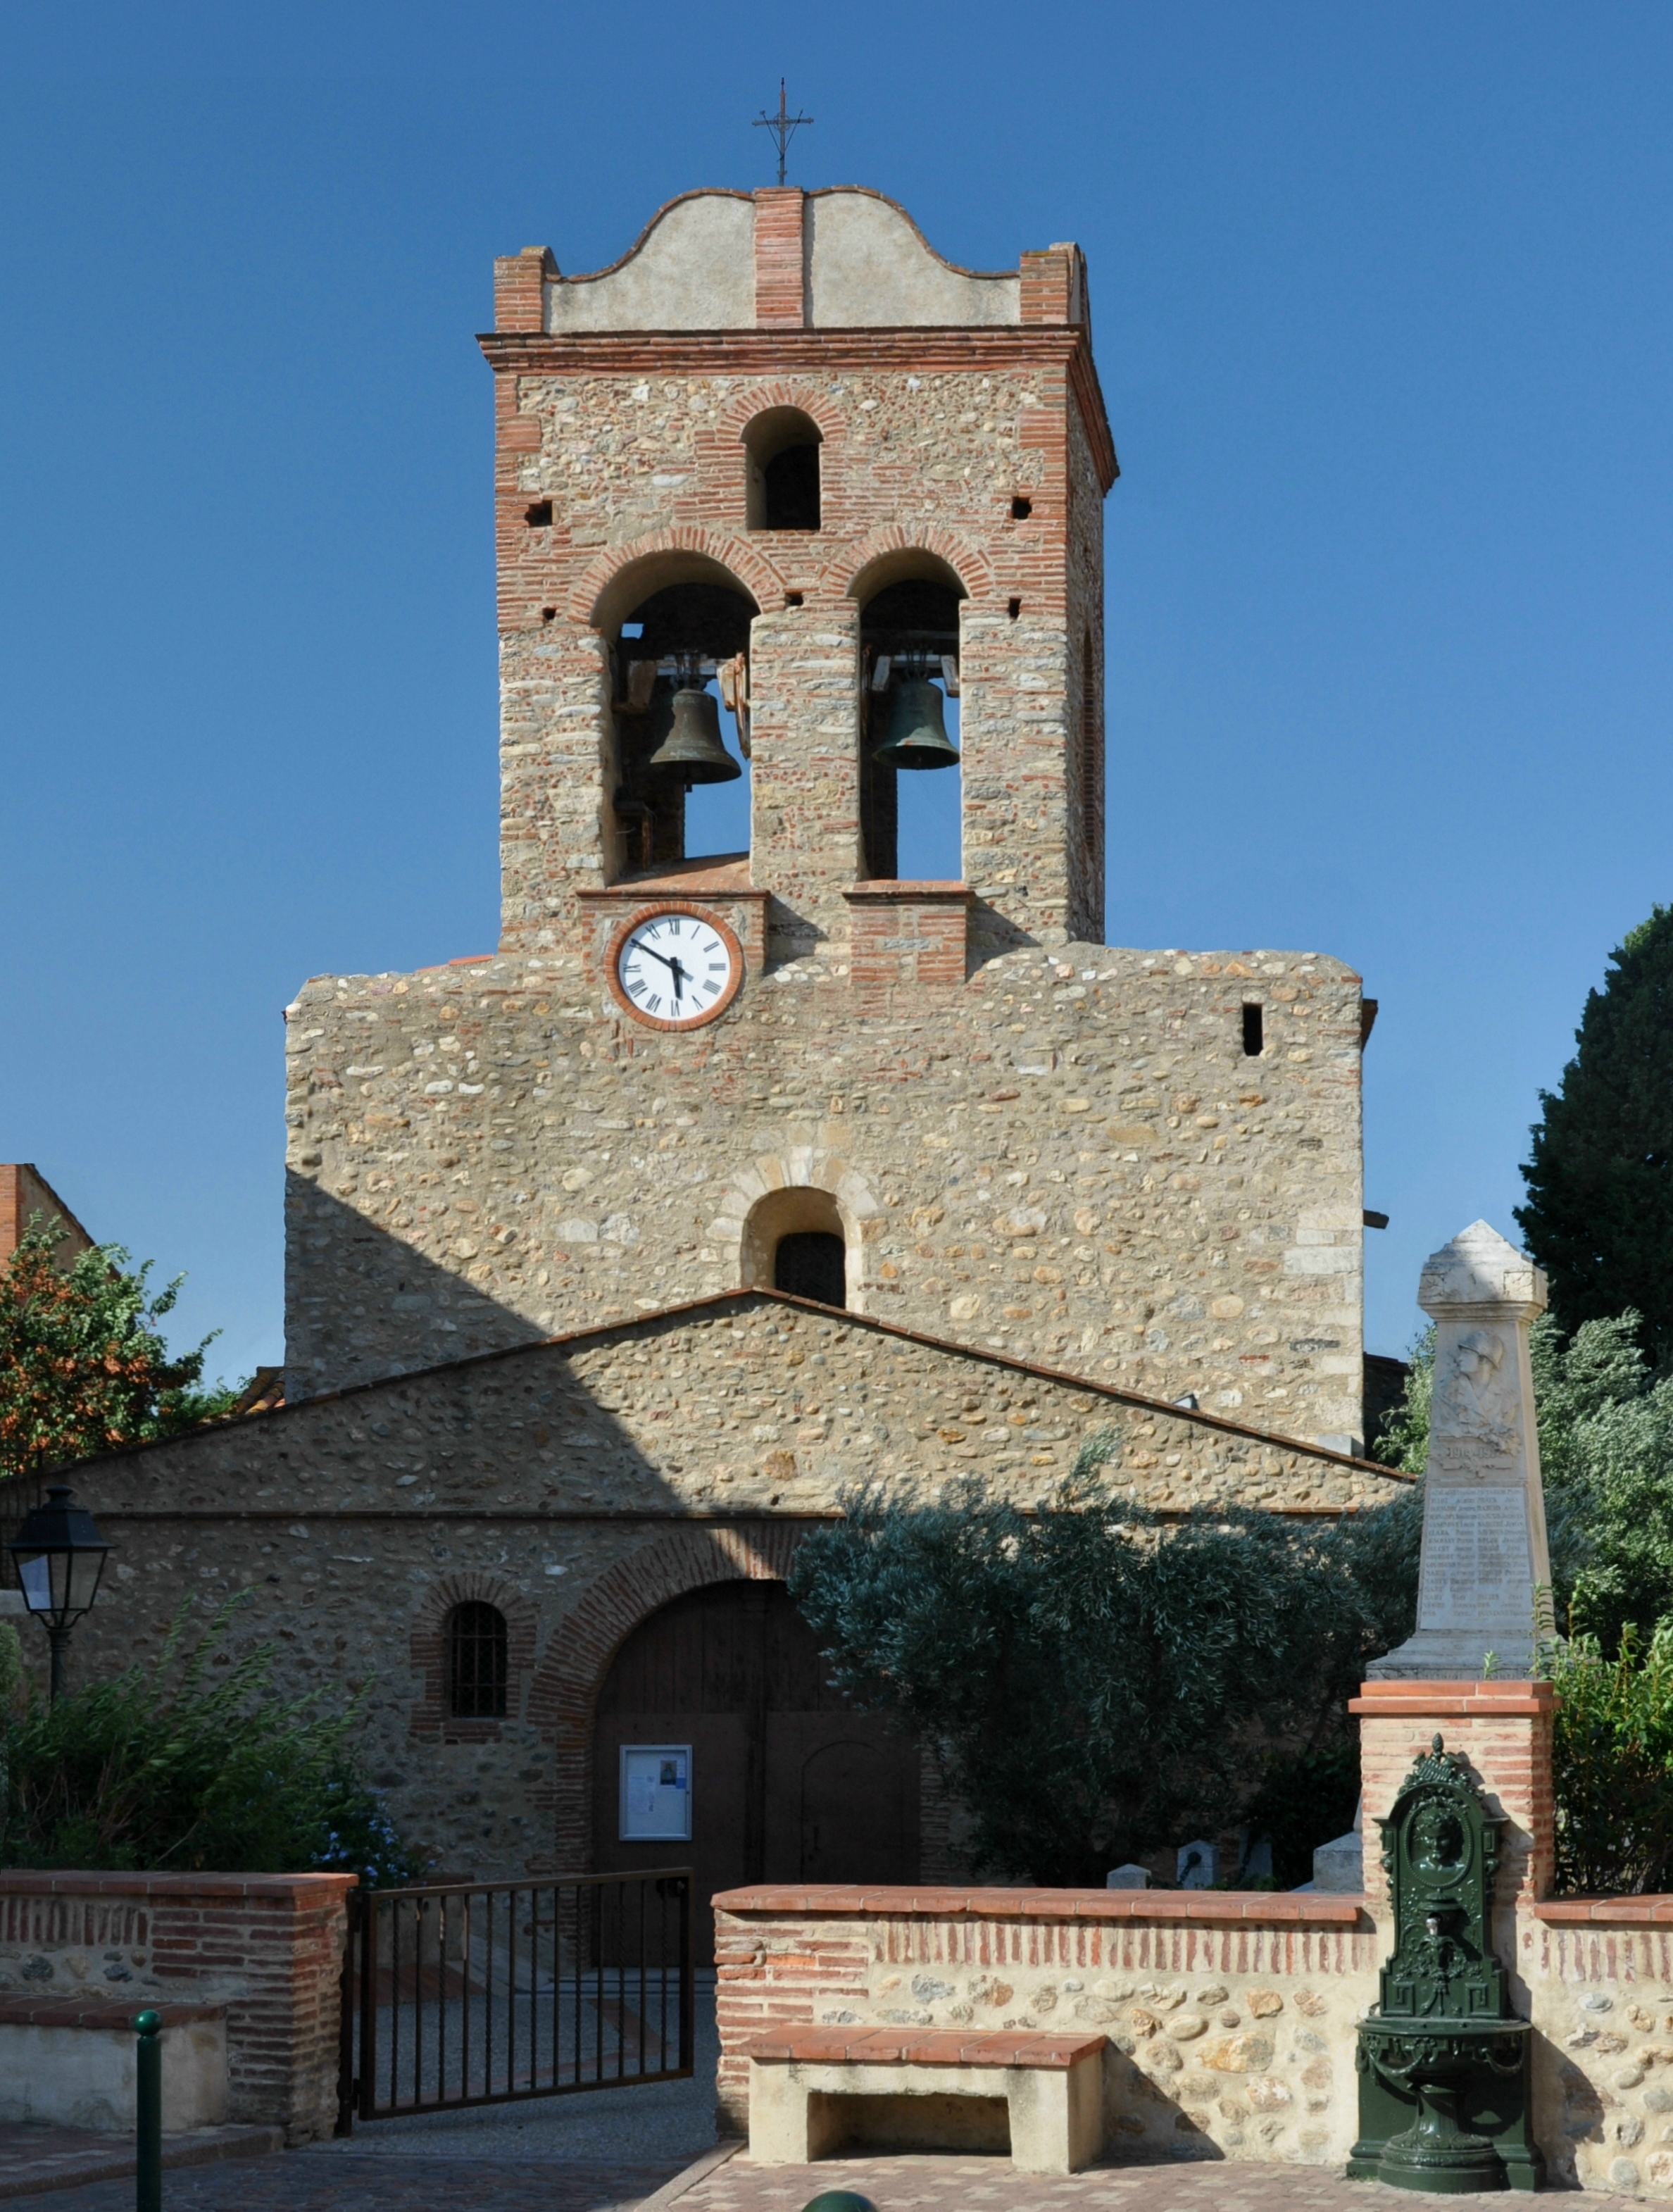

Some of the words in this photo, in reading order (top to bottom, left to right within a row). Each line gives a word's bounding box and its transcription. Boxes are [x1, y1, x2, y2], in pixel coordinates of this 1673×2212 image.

[645, 924, 661, 942] XI
[668, 918, 679, 935] XII
[703, 941, 720, 953] II
[627, 979, 648, 998] VIII
[703, 980, 722, 995] IIII
[646, 994, 662, 1013] VII
[671, 999, 679, 1016] VI
[691, 995, 703, 1011] V
